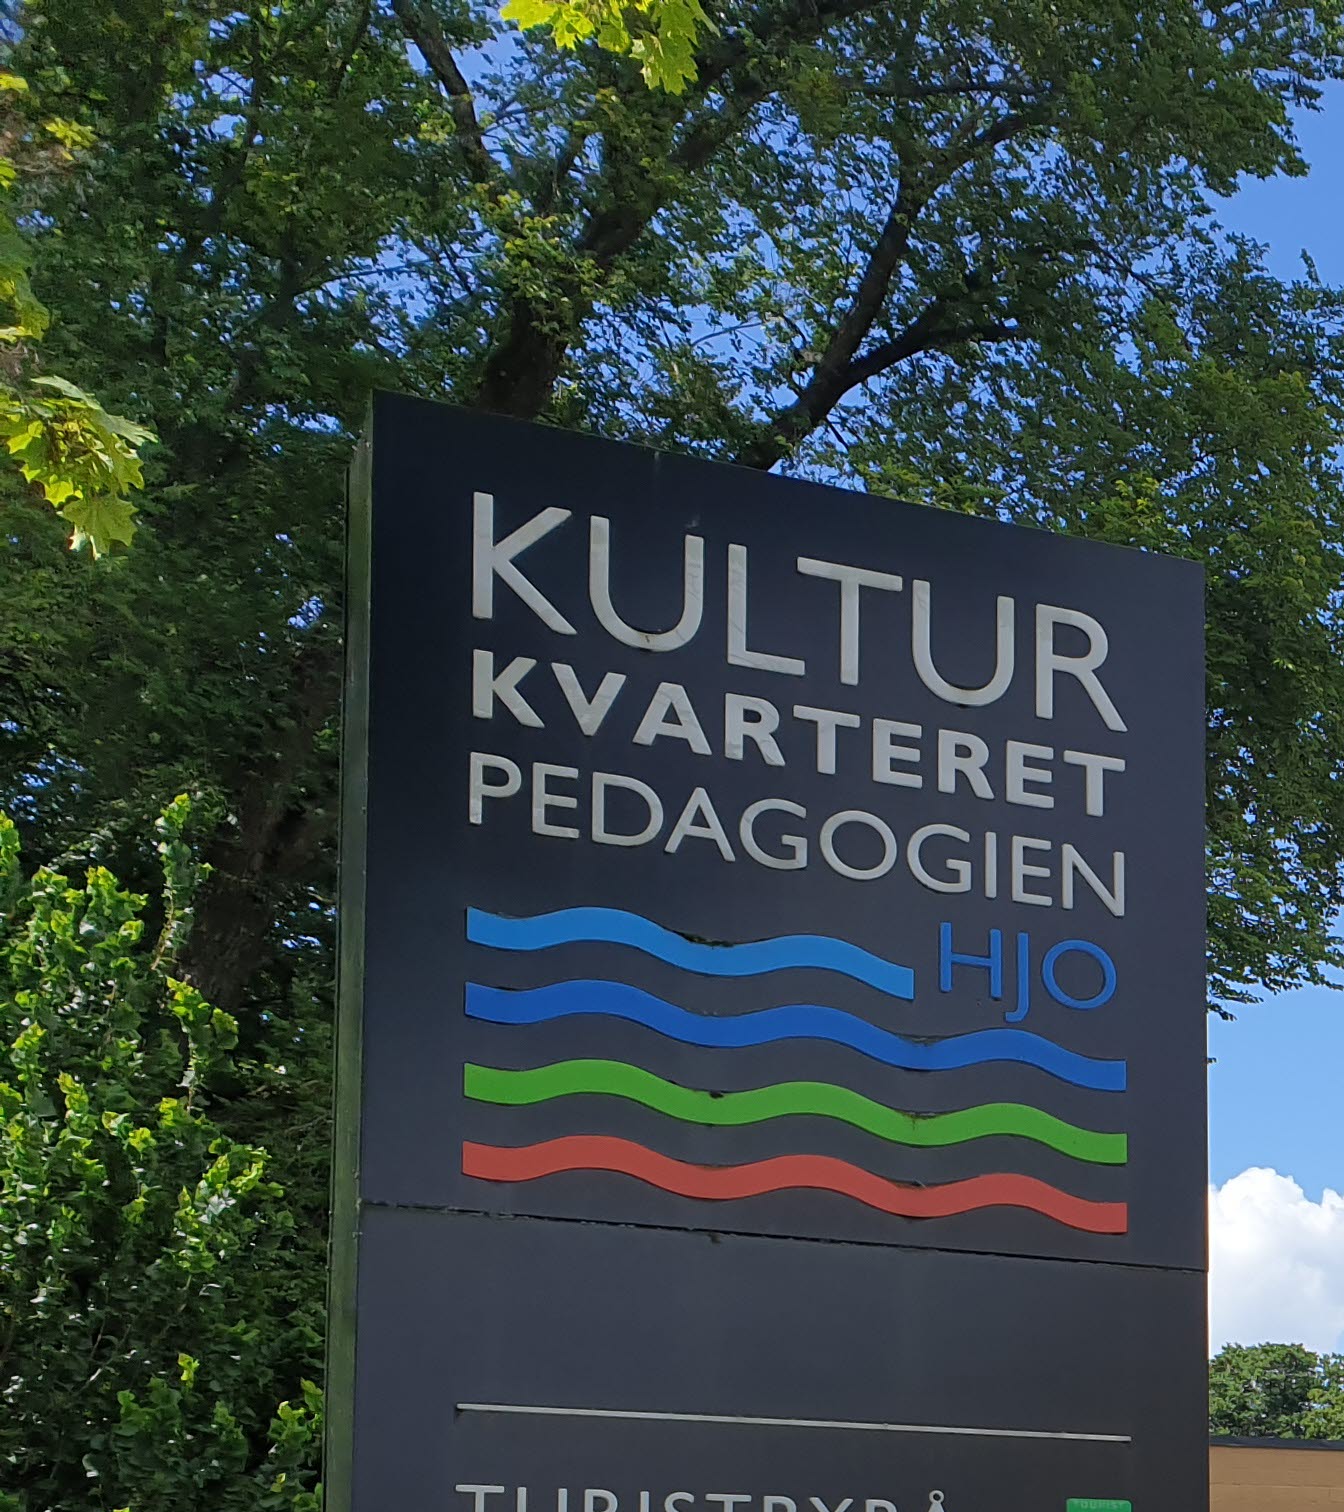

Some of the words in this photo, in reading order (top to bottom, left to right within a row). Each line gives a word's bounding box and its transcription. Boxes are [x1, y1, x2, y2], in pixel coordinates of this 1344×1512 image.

[473, 491, 1127, 733] KULTUR
[473, 649, 1126, 817] KVARTERET
[469, 752, 1125, 917] PEDAGOGIEN
[939, 922, 1117, 1023] HJO
